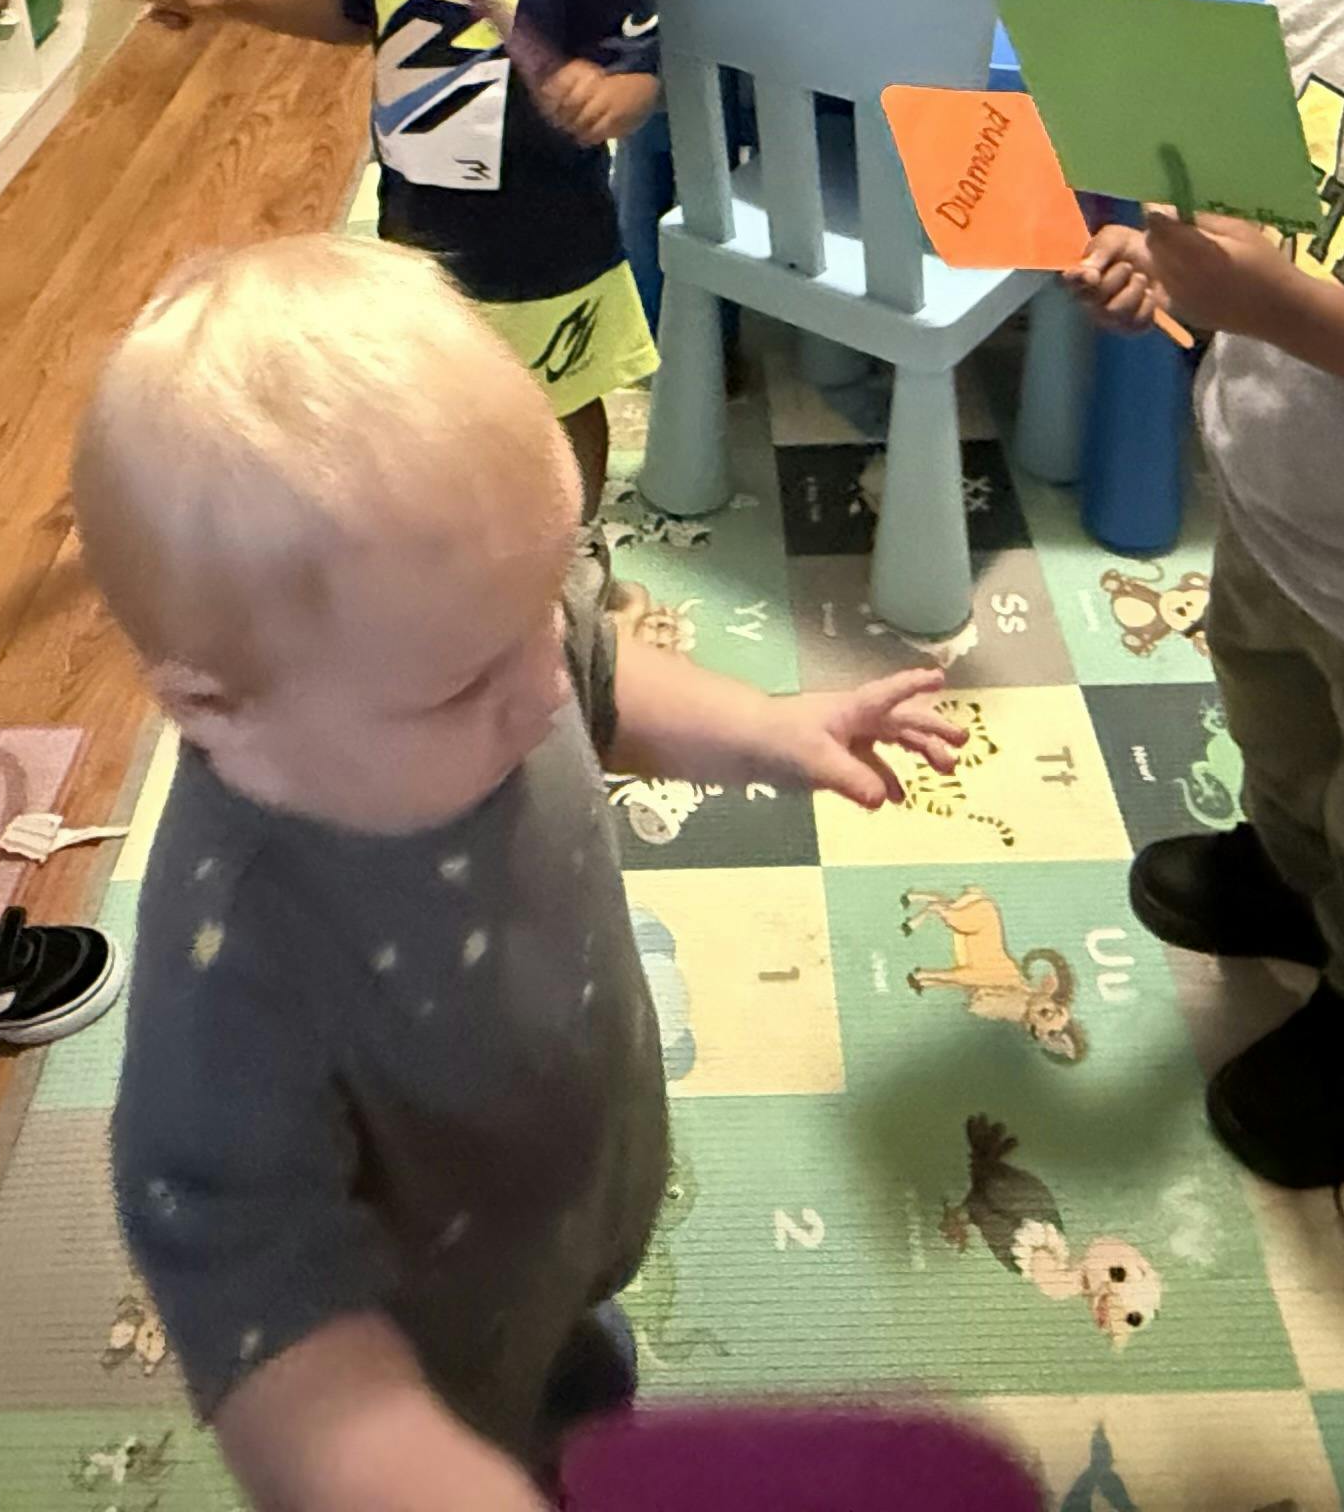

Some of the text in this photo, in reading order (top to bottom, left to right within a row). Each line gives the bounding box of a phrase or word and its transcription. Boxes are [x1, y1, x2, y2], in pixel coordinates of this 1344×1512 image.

[724, 599, 769, 643] Yy
[990, 592, 1028, 635] Ss
[1033, 743, 1075, 789] Tt
[1083, 926, 1139, 1002] Uu
[772, 1206, 826, 1252] 2
